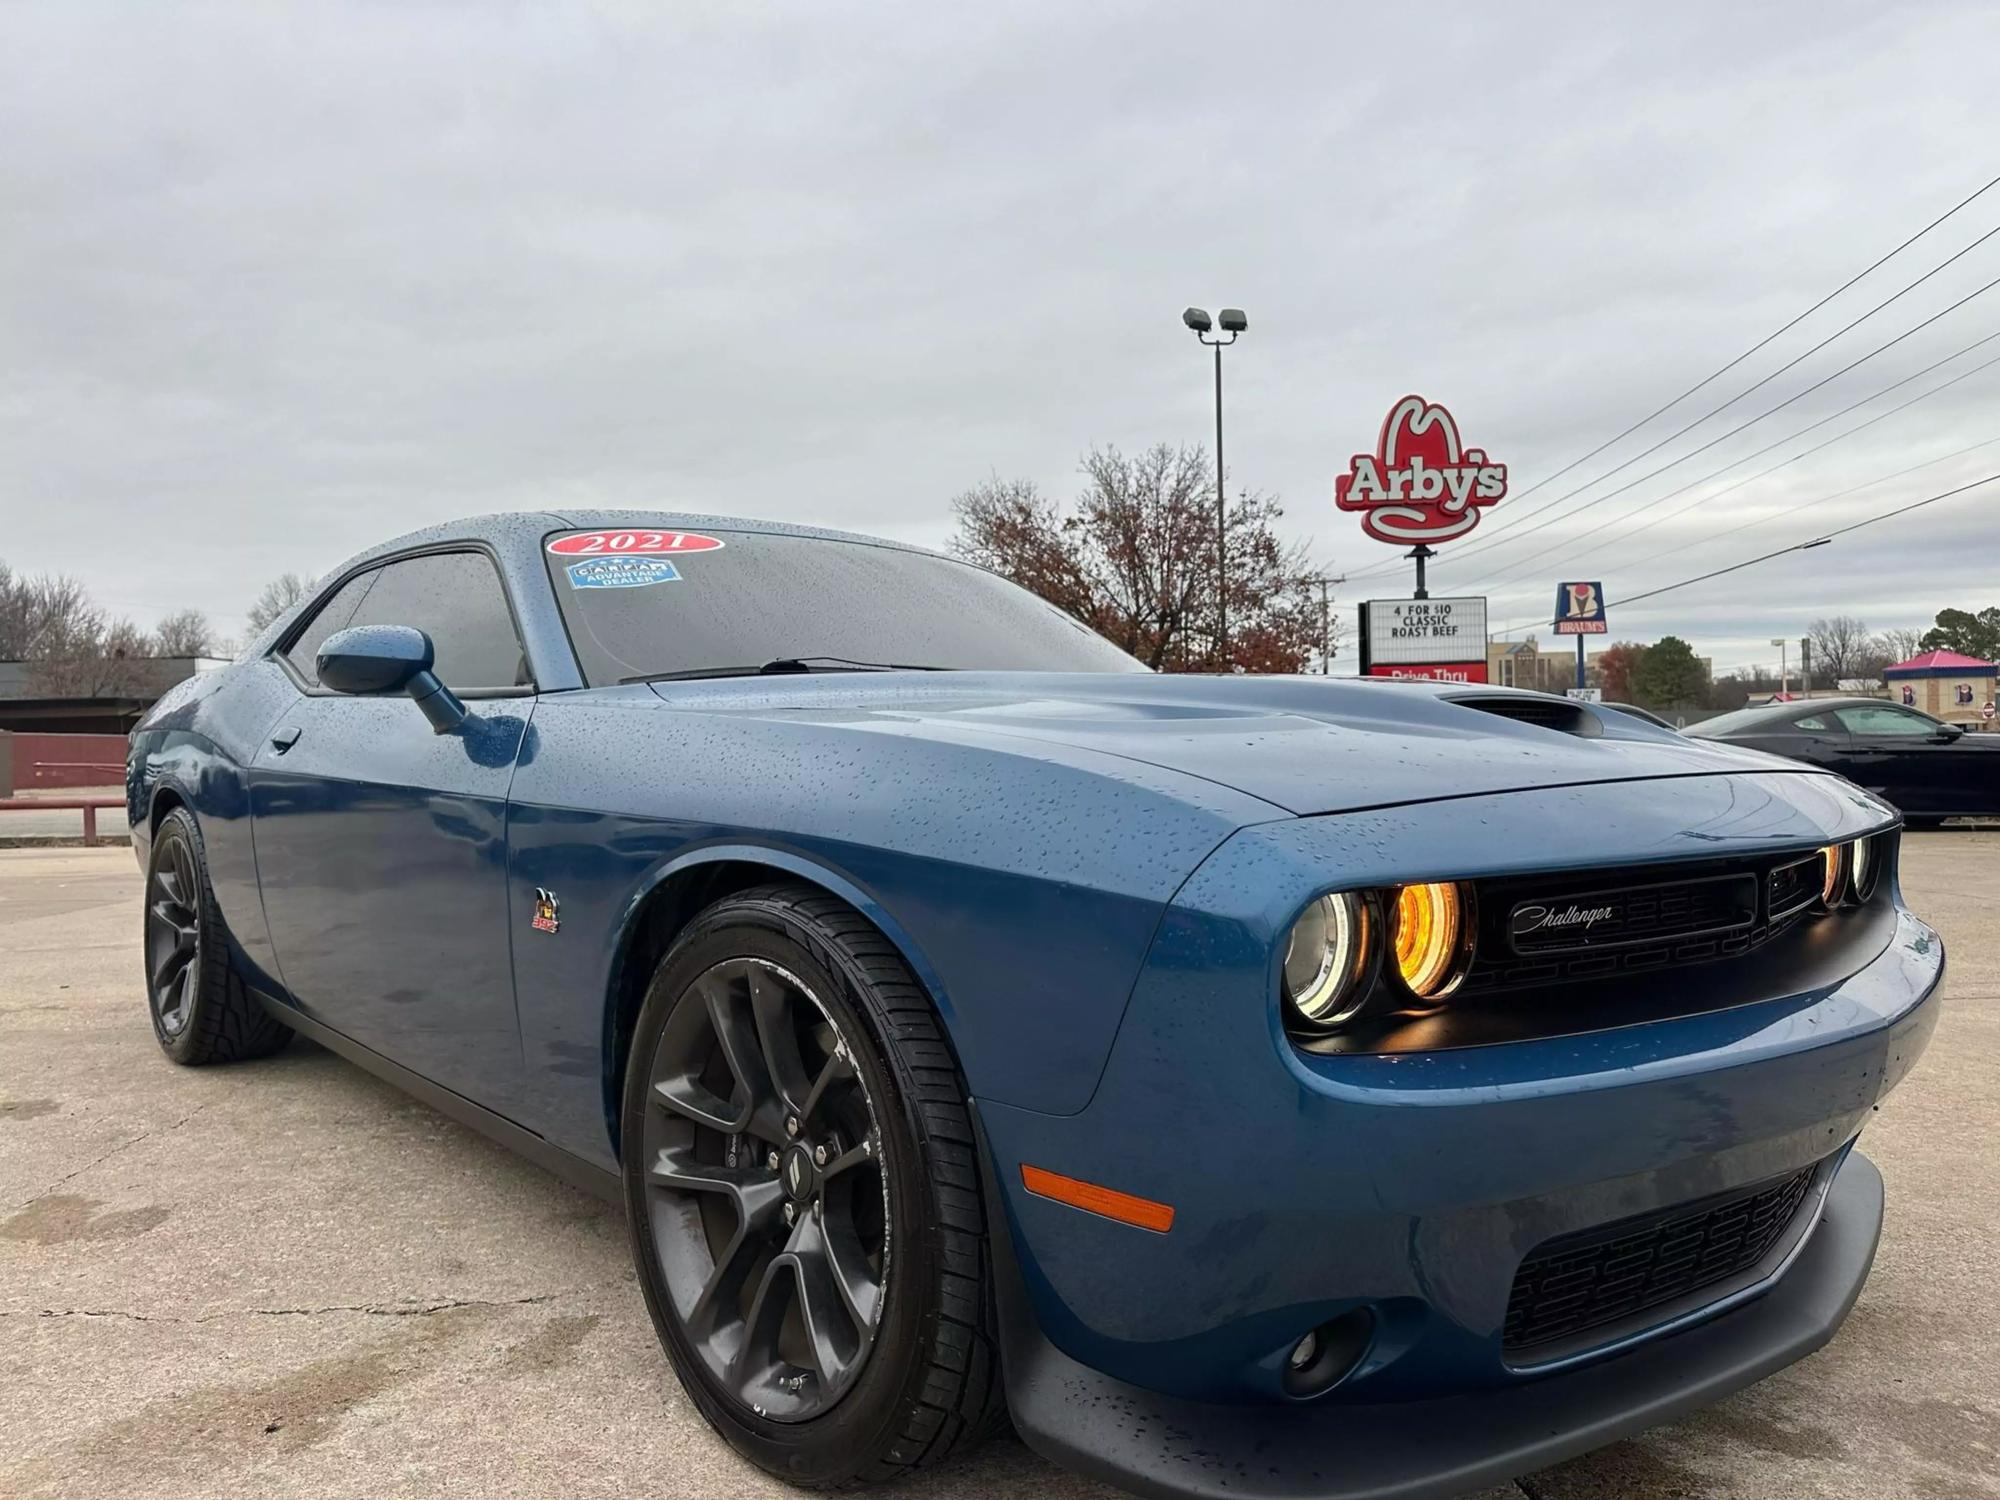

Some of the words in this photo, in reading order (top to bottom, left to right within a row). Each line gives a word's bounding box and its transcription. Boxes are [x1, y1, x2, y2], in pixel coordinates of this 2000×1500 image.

[1346, 452, 1504, 511] Arby's
[579, 533, 687, 553] 2021
[575, 563, 668, 576] CARFAX
[587, 570, 666, 583] ADVANTAGE
[603, 576, 654, 586] DEALER
[1394, 605, 1401, 616] 4
[1408, 605, 1430, 615] FOR
[1434, 604, 1452, 615] $10
[1403, 615, 1448, 627] CLASSIC
[1560, 621, 1605, 633] BRAUM'S
[1392, 627, 1428, 638] ROAST
[1432, 625, 1459, 637] BEEF
[1391, 669, 1430, 681] Drive
[1433, 668, 1468, 682] Thru
[532, 917, 557, 933] 392
[1513, 905, 1612, 934] Challenger
